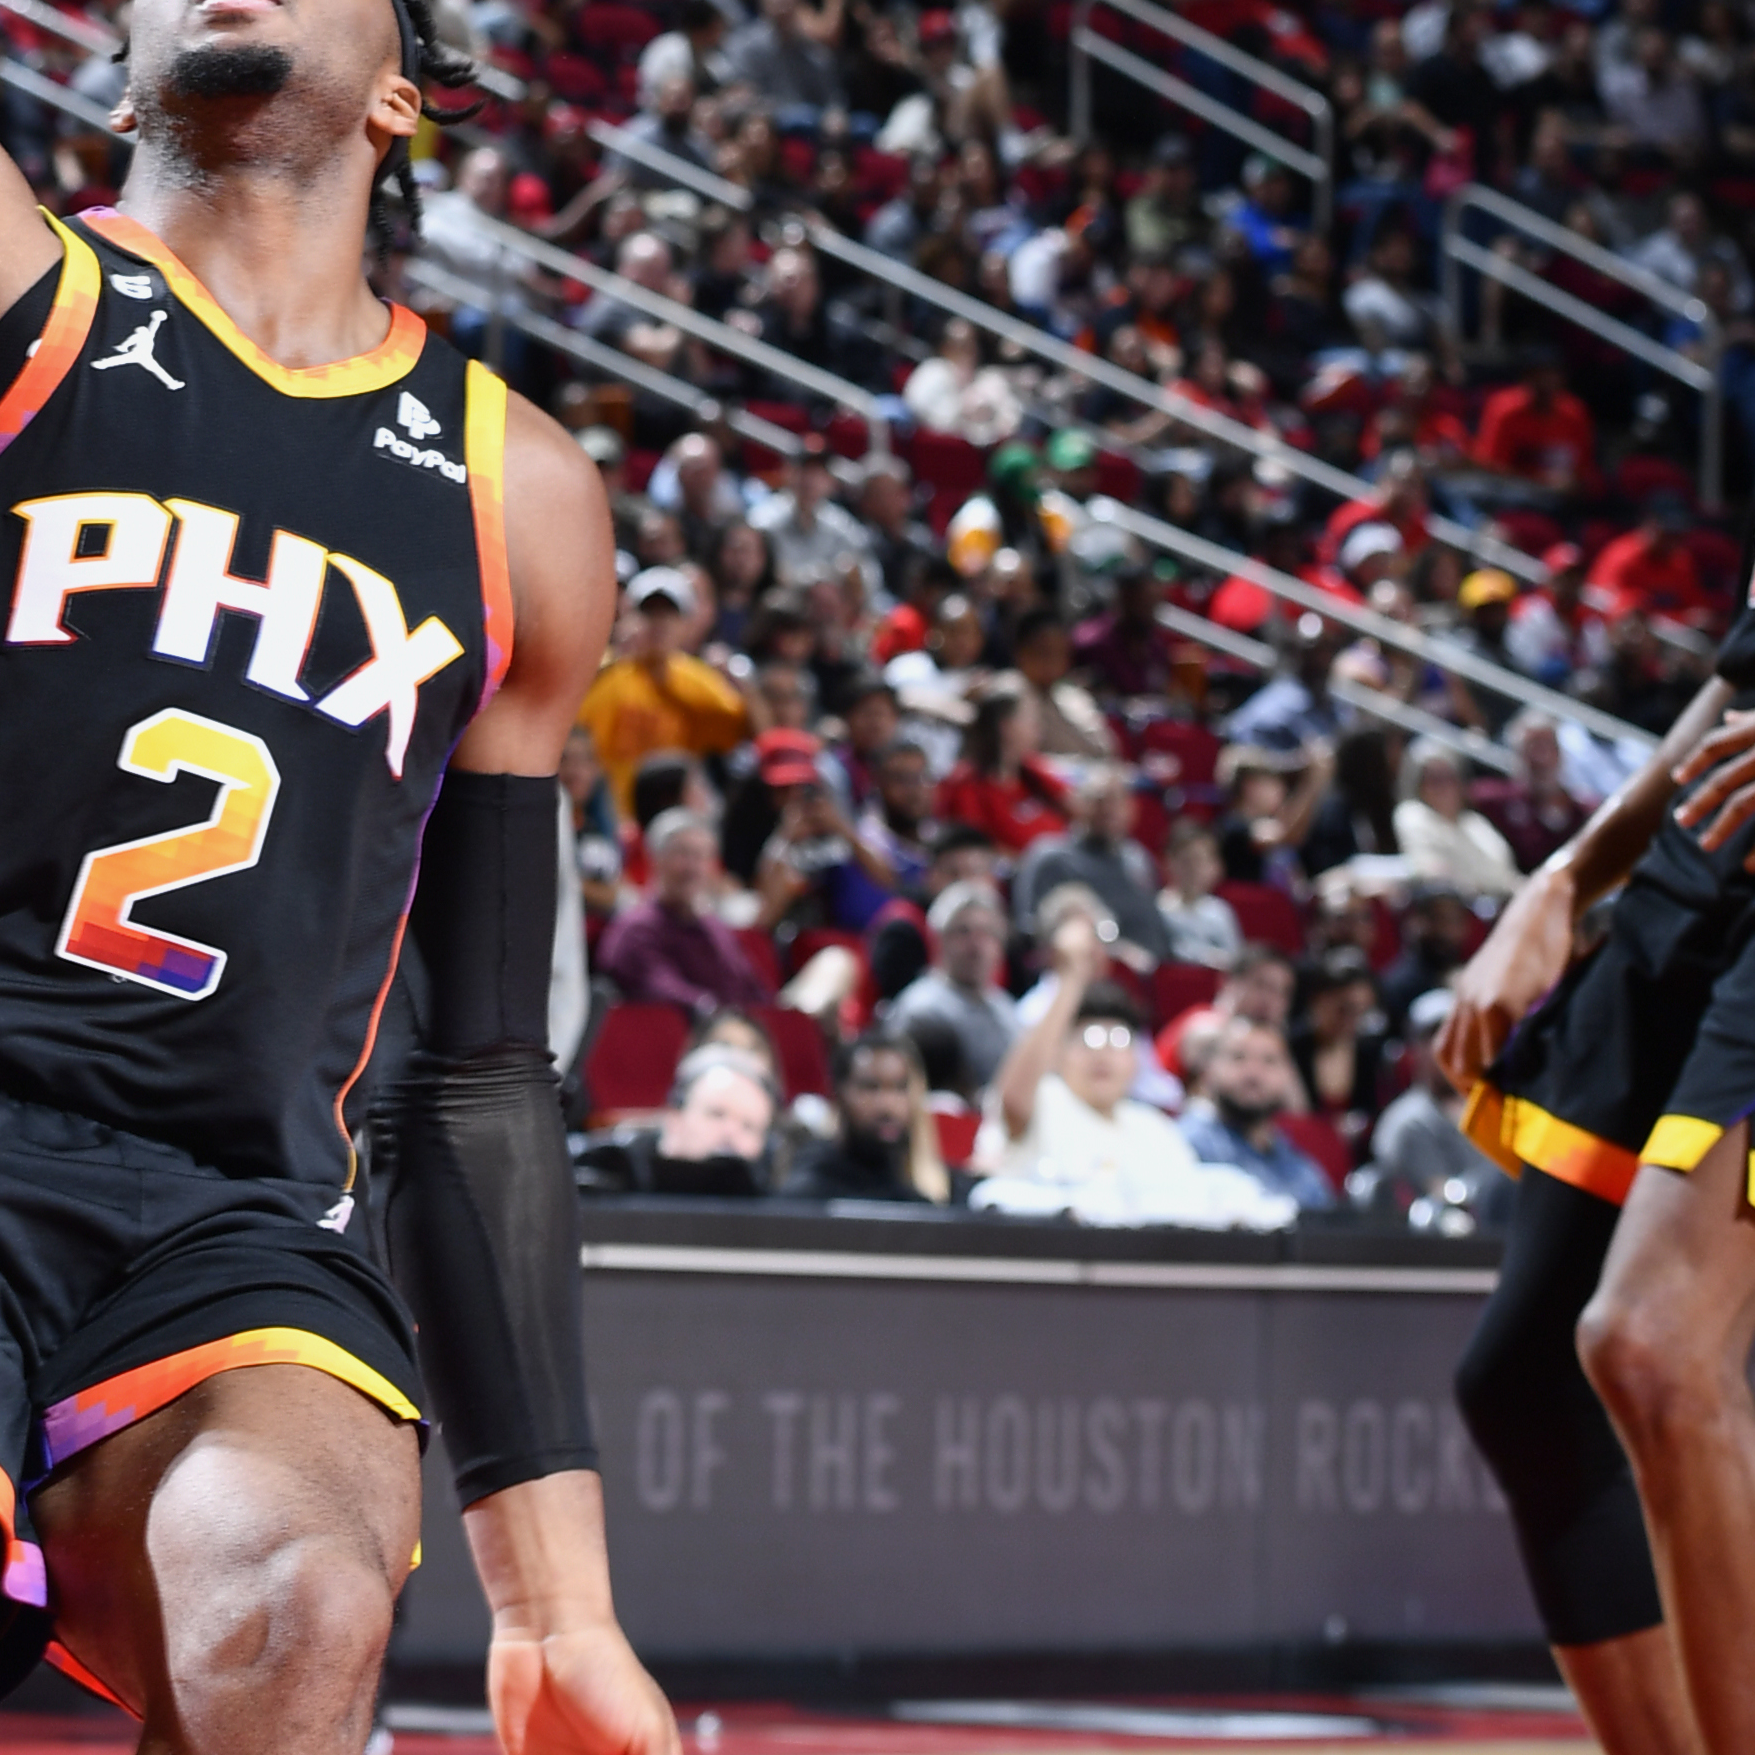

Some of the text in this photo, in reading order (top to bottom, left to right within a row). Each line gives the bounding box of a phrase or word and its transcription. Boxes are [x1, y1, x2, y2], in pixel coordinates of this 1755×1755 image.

[373, 426, 467, 484] PayPal
[4, 491, 466, 782] PHX
[54, 706, 282, 1002] 2
[635, 1388, 1509, 1518] OF THE HOUSTON ROCK
